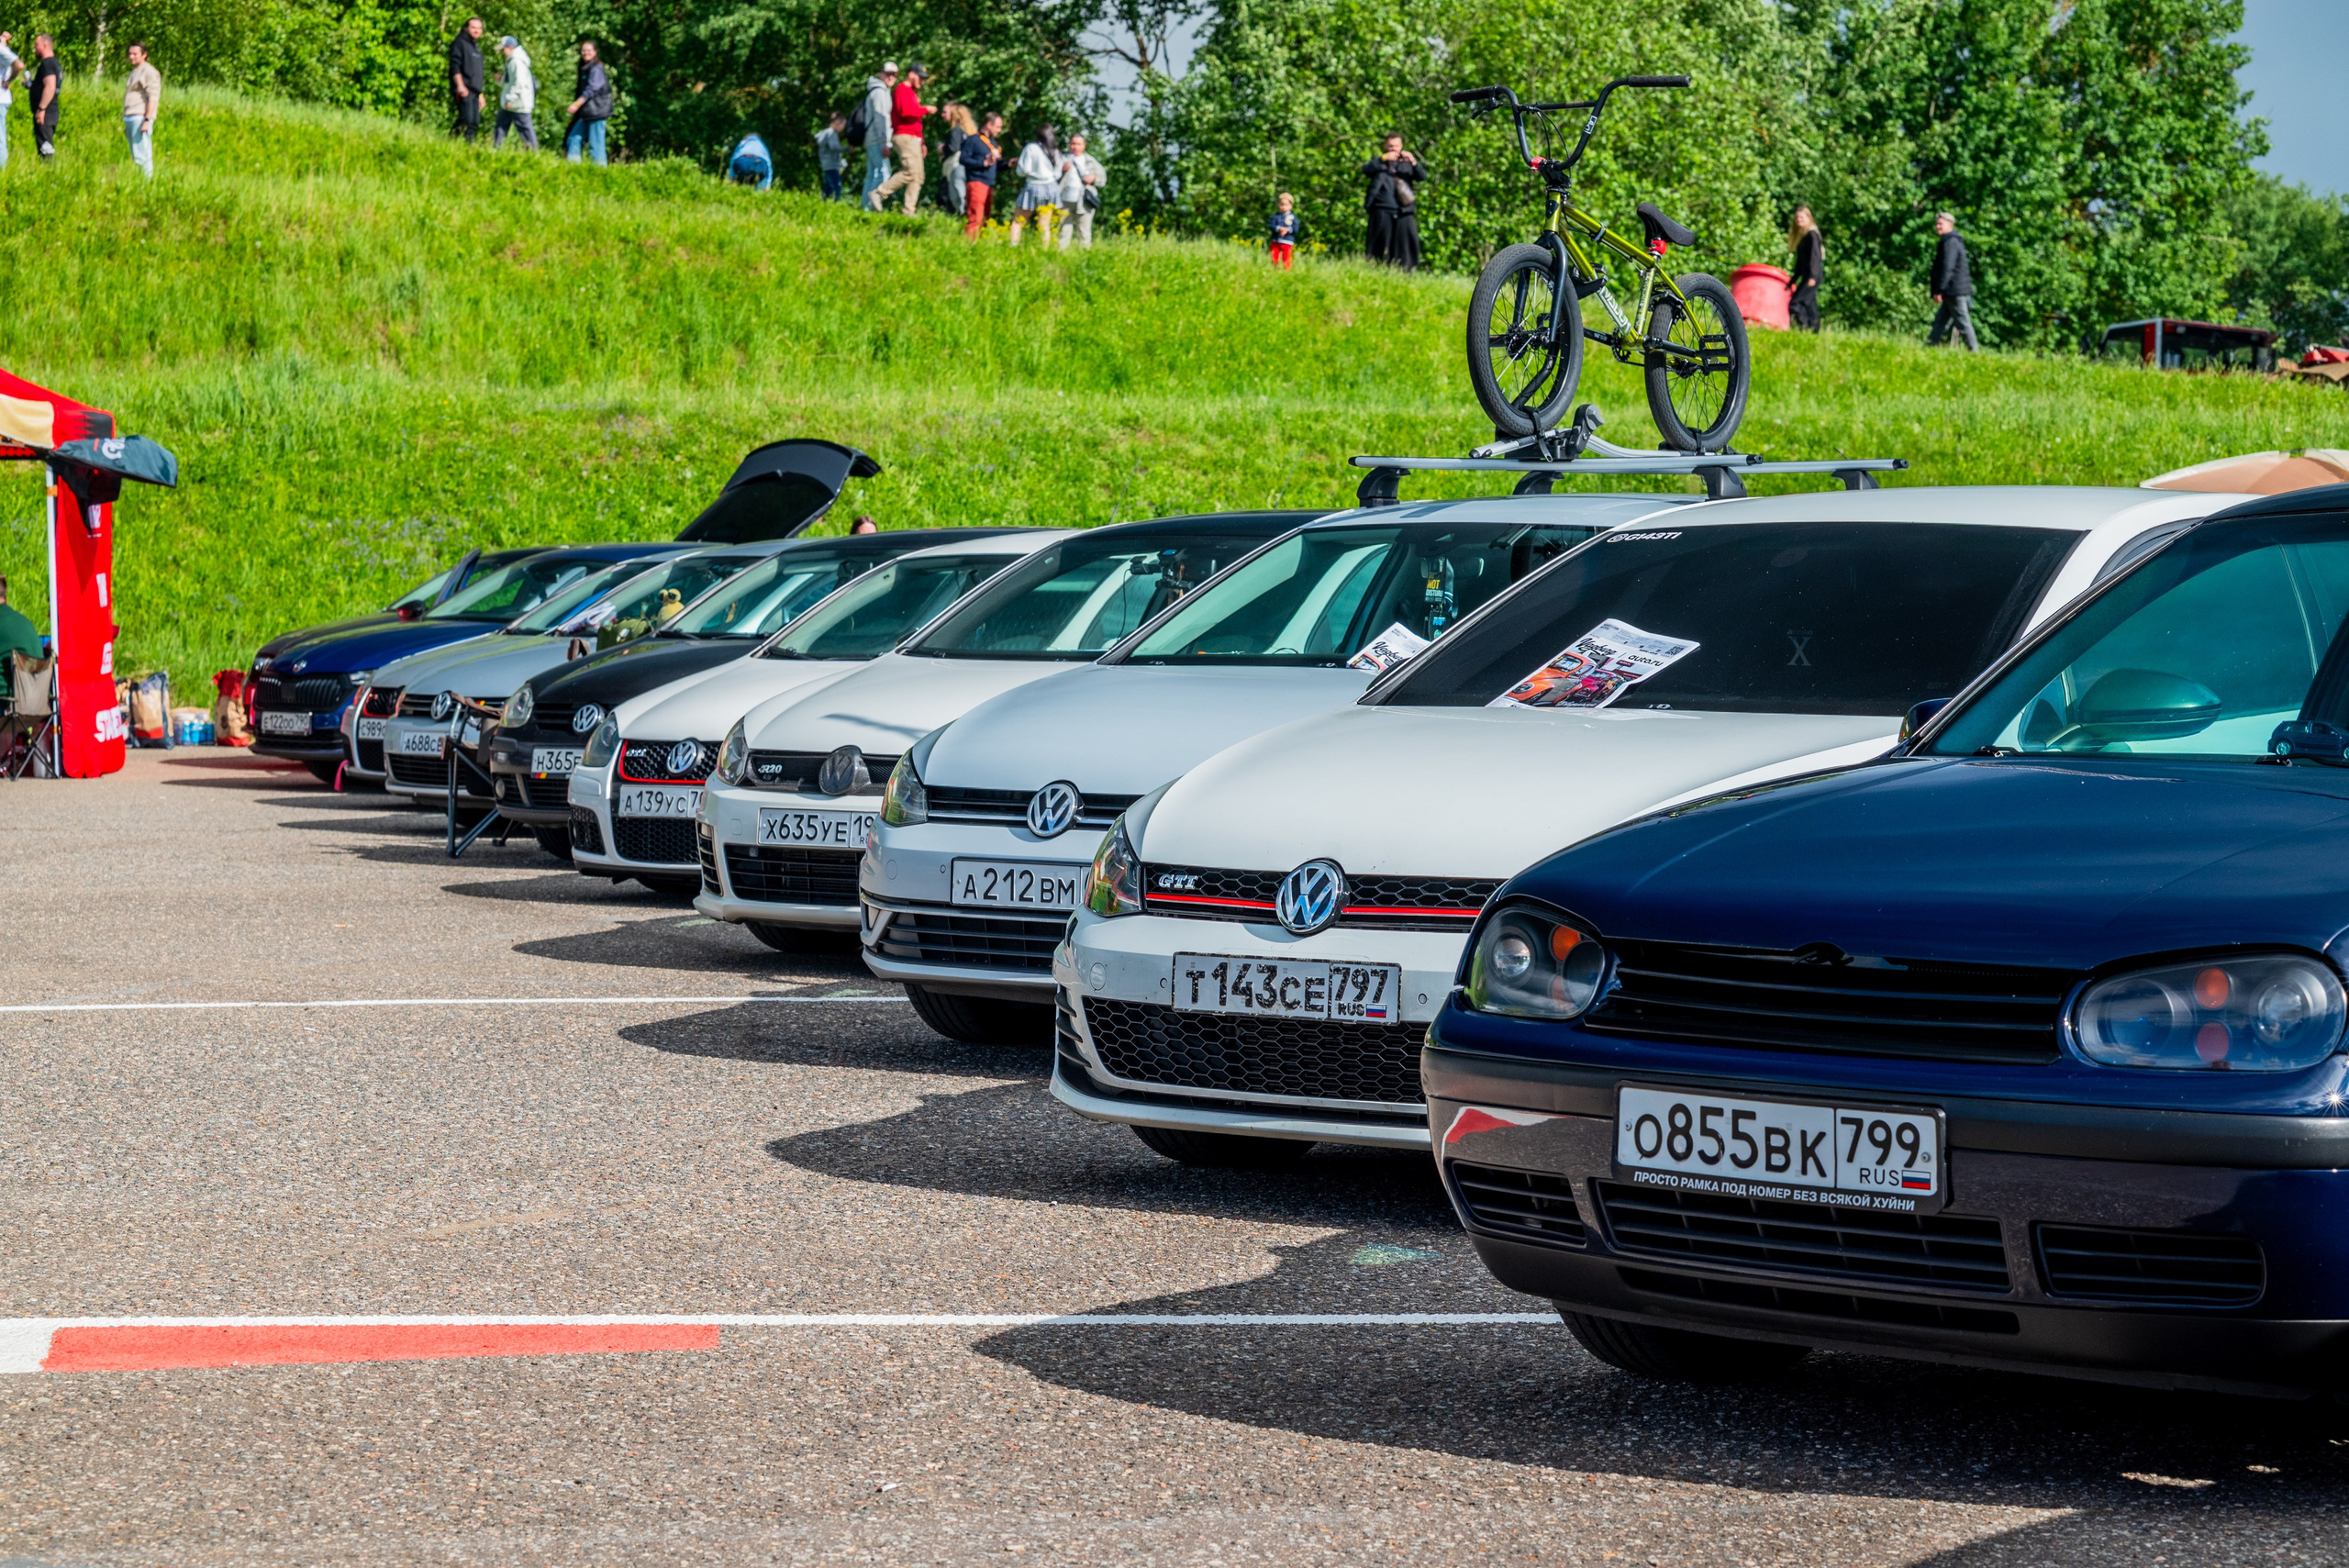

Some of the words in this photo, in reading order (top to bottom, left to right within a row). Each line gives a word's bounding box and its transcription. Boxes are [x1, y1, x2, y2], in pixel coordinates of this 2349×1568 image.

[1427, 579, 1440, 590] NOT
[1627, 653, 1664, 667] auto.ru
[624, 791, 686, 813] А139УС
[766, 813, 848, 842] Х635УЕ
[963, 867, 1076, 905] А212ВМ
[1158, 873, 1199, 891] GTI
[1186, 962, 1326, 1013] Т143СЕ
[1332, 965, 1388, 1004] 797
[1338, 1001, 1364, 1017] RUS
[1634, 1103, 1827, 1178] О855ВК
[1840, 1117, 1920, 1168] 799
[1859, 1168, 1899, 1186] RUS
[1633, 1171, 1679, 1187] ПРОСТО
[1680, 1177, 1720, 1192] РАМКА
[1721, 1182, 1747, 1196] ПОД
[1748, 1184, 1791, 1199] НОМЕР
[1793, 1189, 1818, 1202] БЕЗ
[1820, 1191, 1870, 1207] ВСЯКОЙ
[1872, 1196, 1916, 1211] ХУЙНИ
